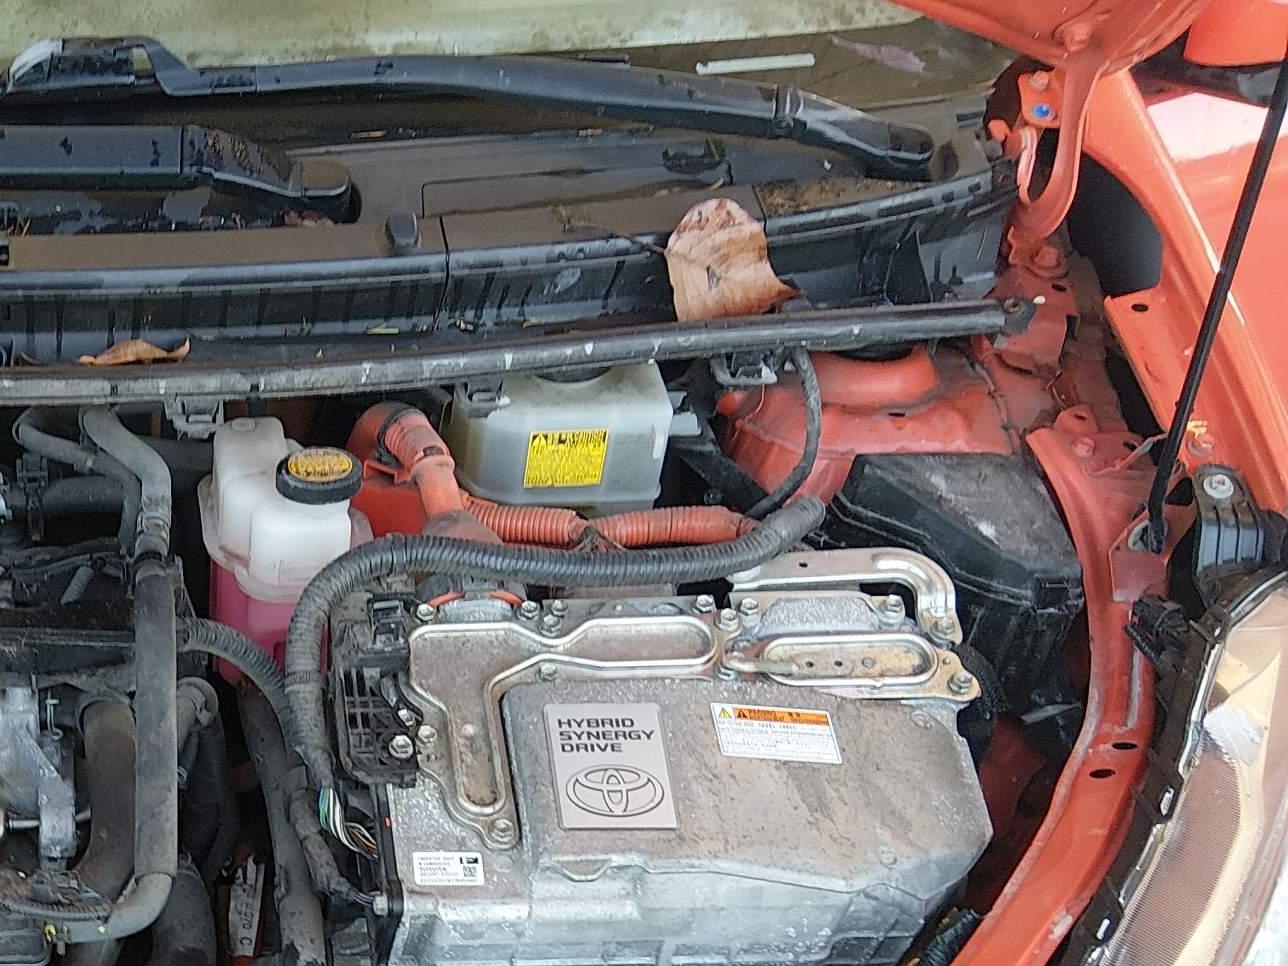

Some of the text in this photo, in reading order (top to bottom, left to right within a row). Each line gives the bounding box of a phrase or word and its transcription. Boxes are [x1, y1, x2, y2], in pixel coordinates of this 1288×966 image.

[557, 718, 634, 728] HYBRID
[559, 730, 654, 741] SYNERGY
[560, 742, 623, 753] DRIVE
